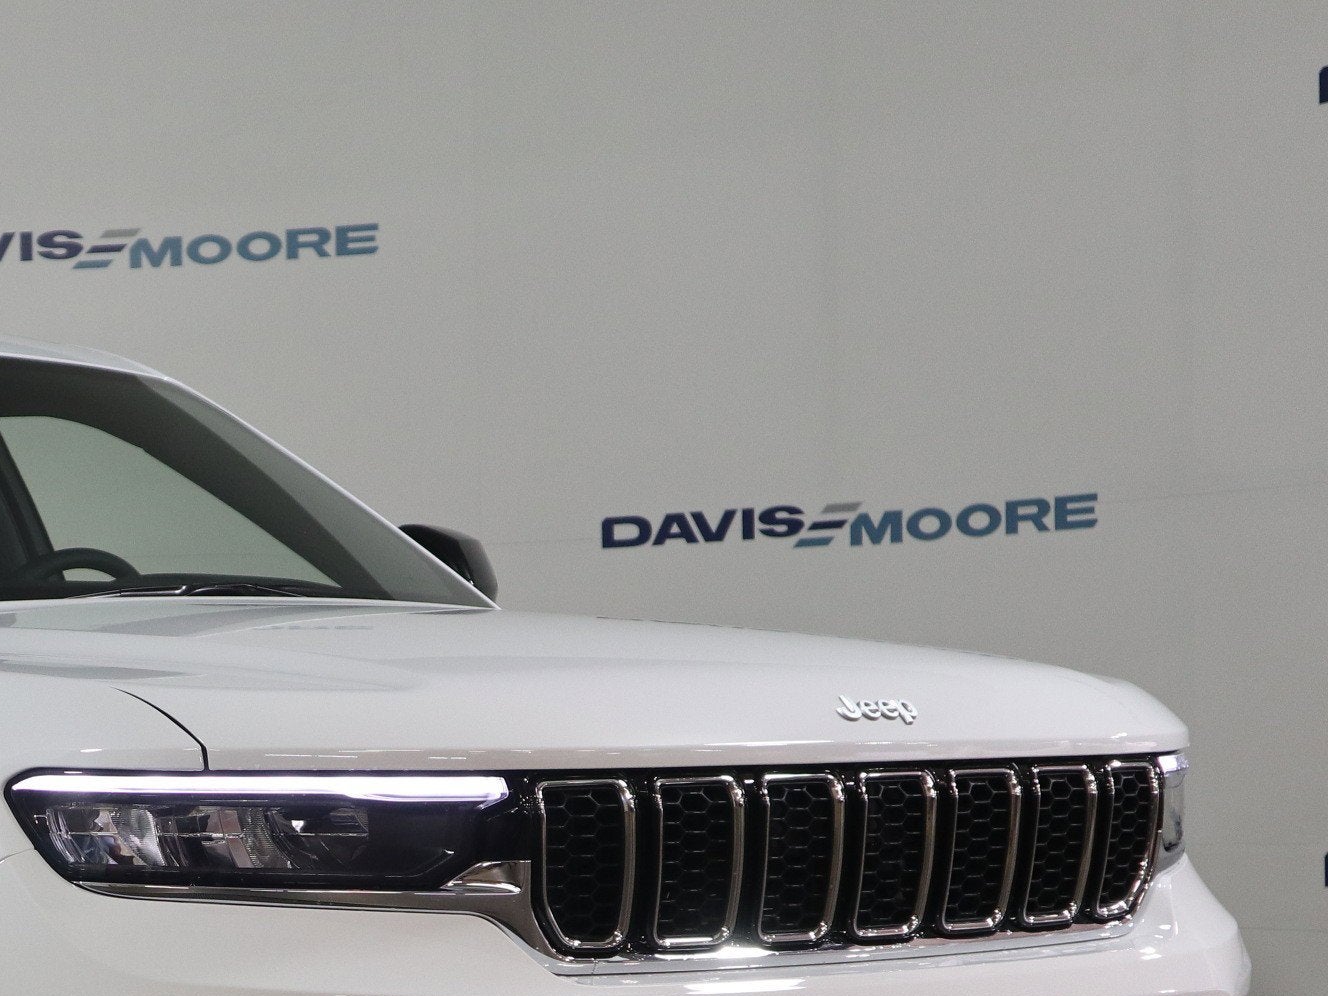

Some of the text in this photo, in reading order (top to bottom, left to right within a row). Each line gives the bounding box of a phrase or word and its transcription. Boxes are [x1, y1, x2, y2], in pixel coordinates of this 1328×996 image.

[129, 222, 379, 269] MOORE
[601, 493, 1099, 549] DAVIS MOORE
[835, 694, 919, 726] Jeep
